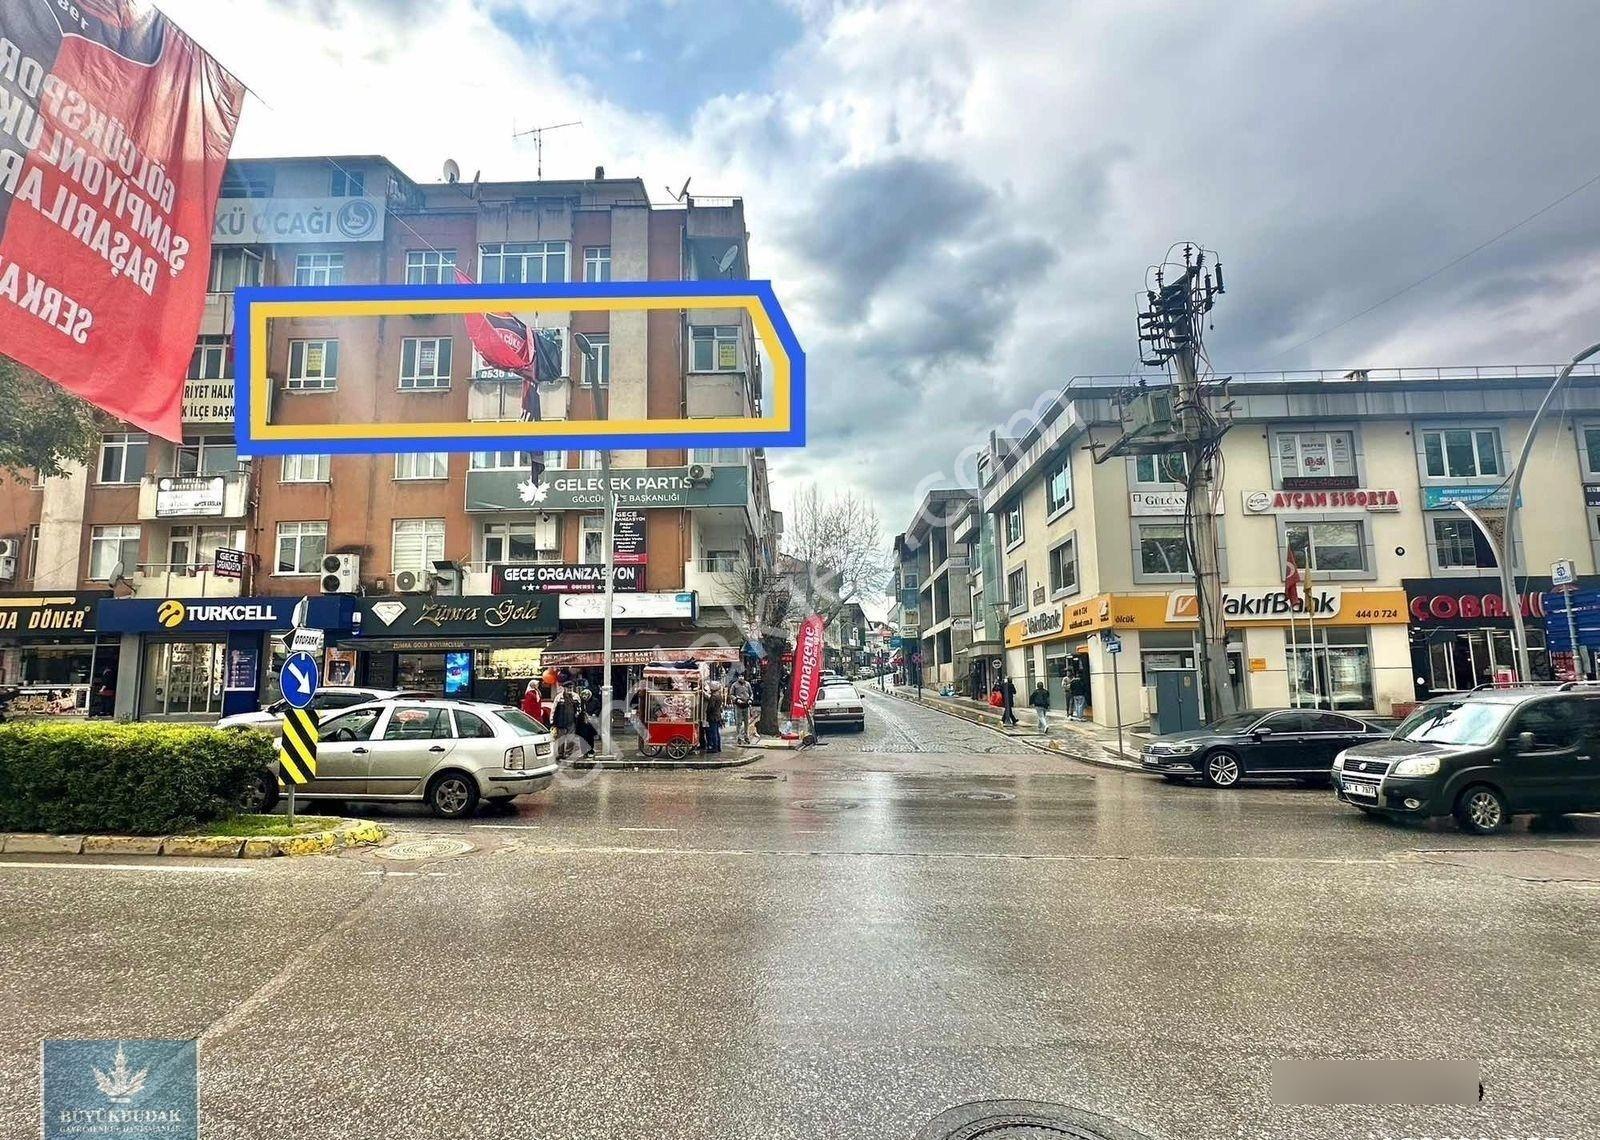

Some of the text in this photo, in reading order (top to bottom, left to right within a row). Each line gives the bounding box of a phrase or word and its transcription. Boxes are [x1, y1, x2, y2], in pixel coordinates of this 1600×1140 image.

[184, 382, 234, 399] RİYET HALK
[190, 403, 209, 420] İLÇE
[629, 492, 680, 503] BAŞKANLIĞI
[1273, 490, 1399, 510] AYÇAM SİGORTA
[219, 552, 239, 562] GECE
[504, 567, 535, 581] GECE
[28, 608, 85, 630] DÖNER
[185, 605, 277, 621] TURKCELL
[484, 598, 542, 628] Gold
[1355, 609, 1398, 618] 444 0 724
[793, 626, 817, 709] komagene
